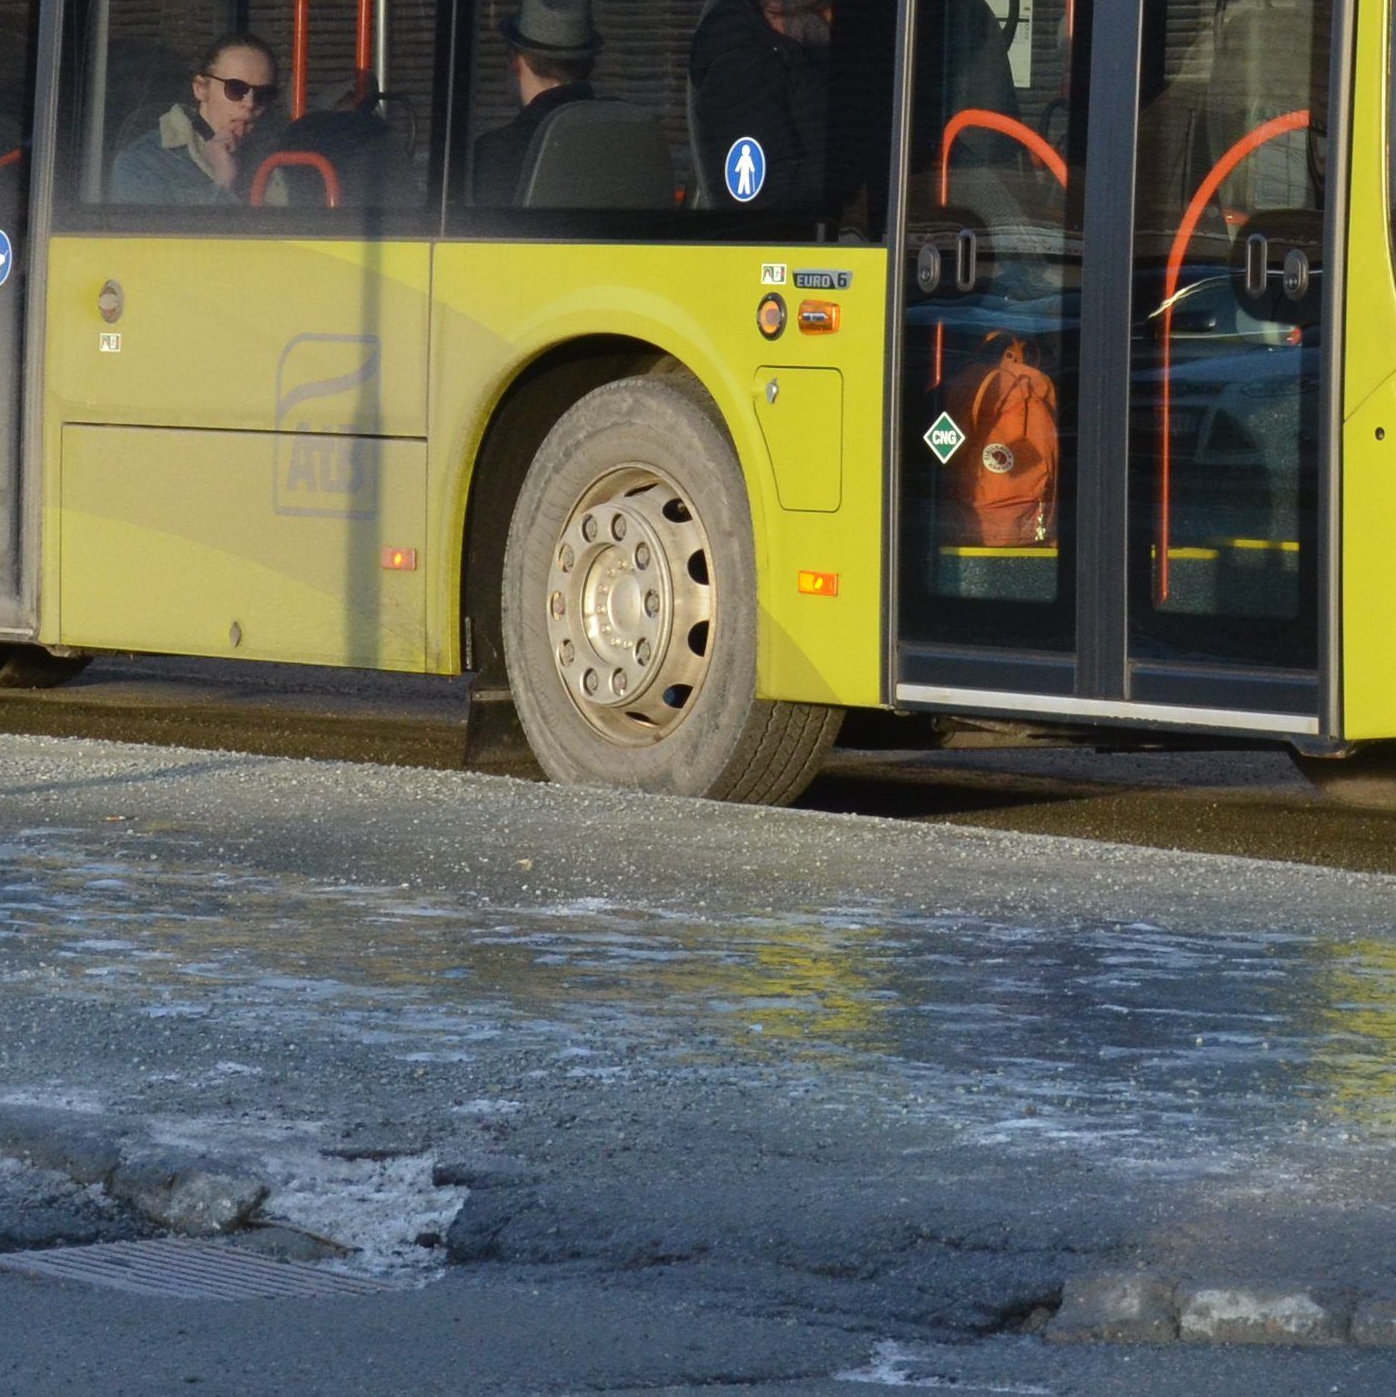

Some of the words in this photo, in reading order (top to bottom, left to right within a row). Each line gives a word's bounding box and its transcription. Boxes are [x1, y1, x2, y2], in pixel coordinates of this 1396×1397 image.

[797, 275, 831, 287] EURO
[837, 272, 847, 287] 6
[932, 430, 957, 444] CNG
